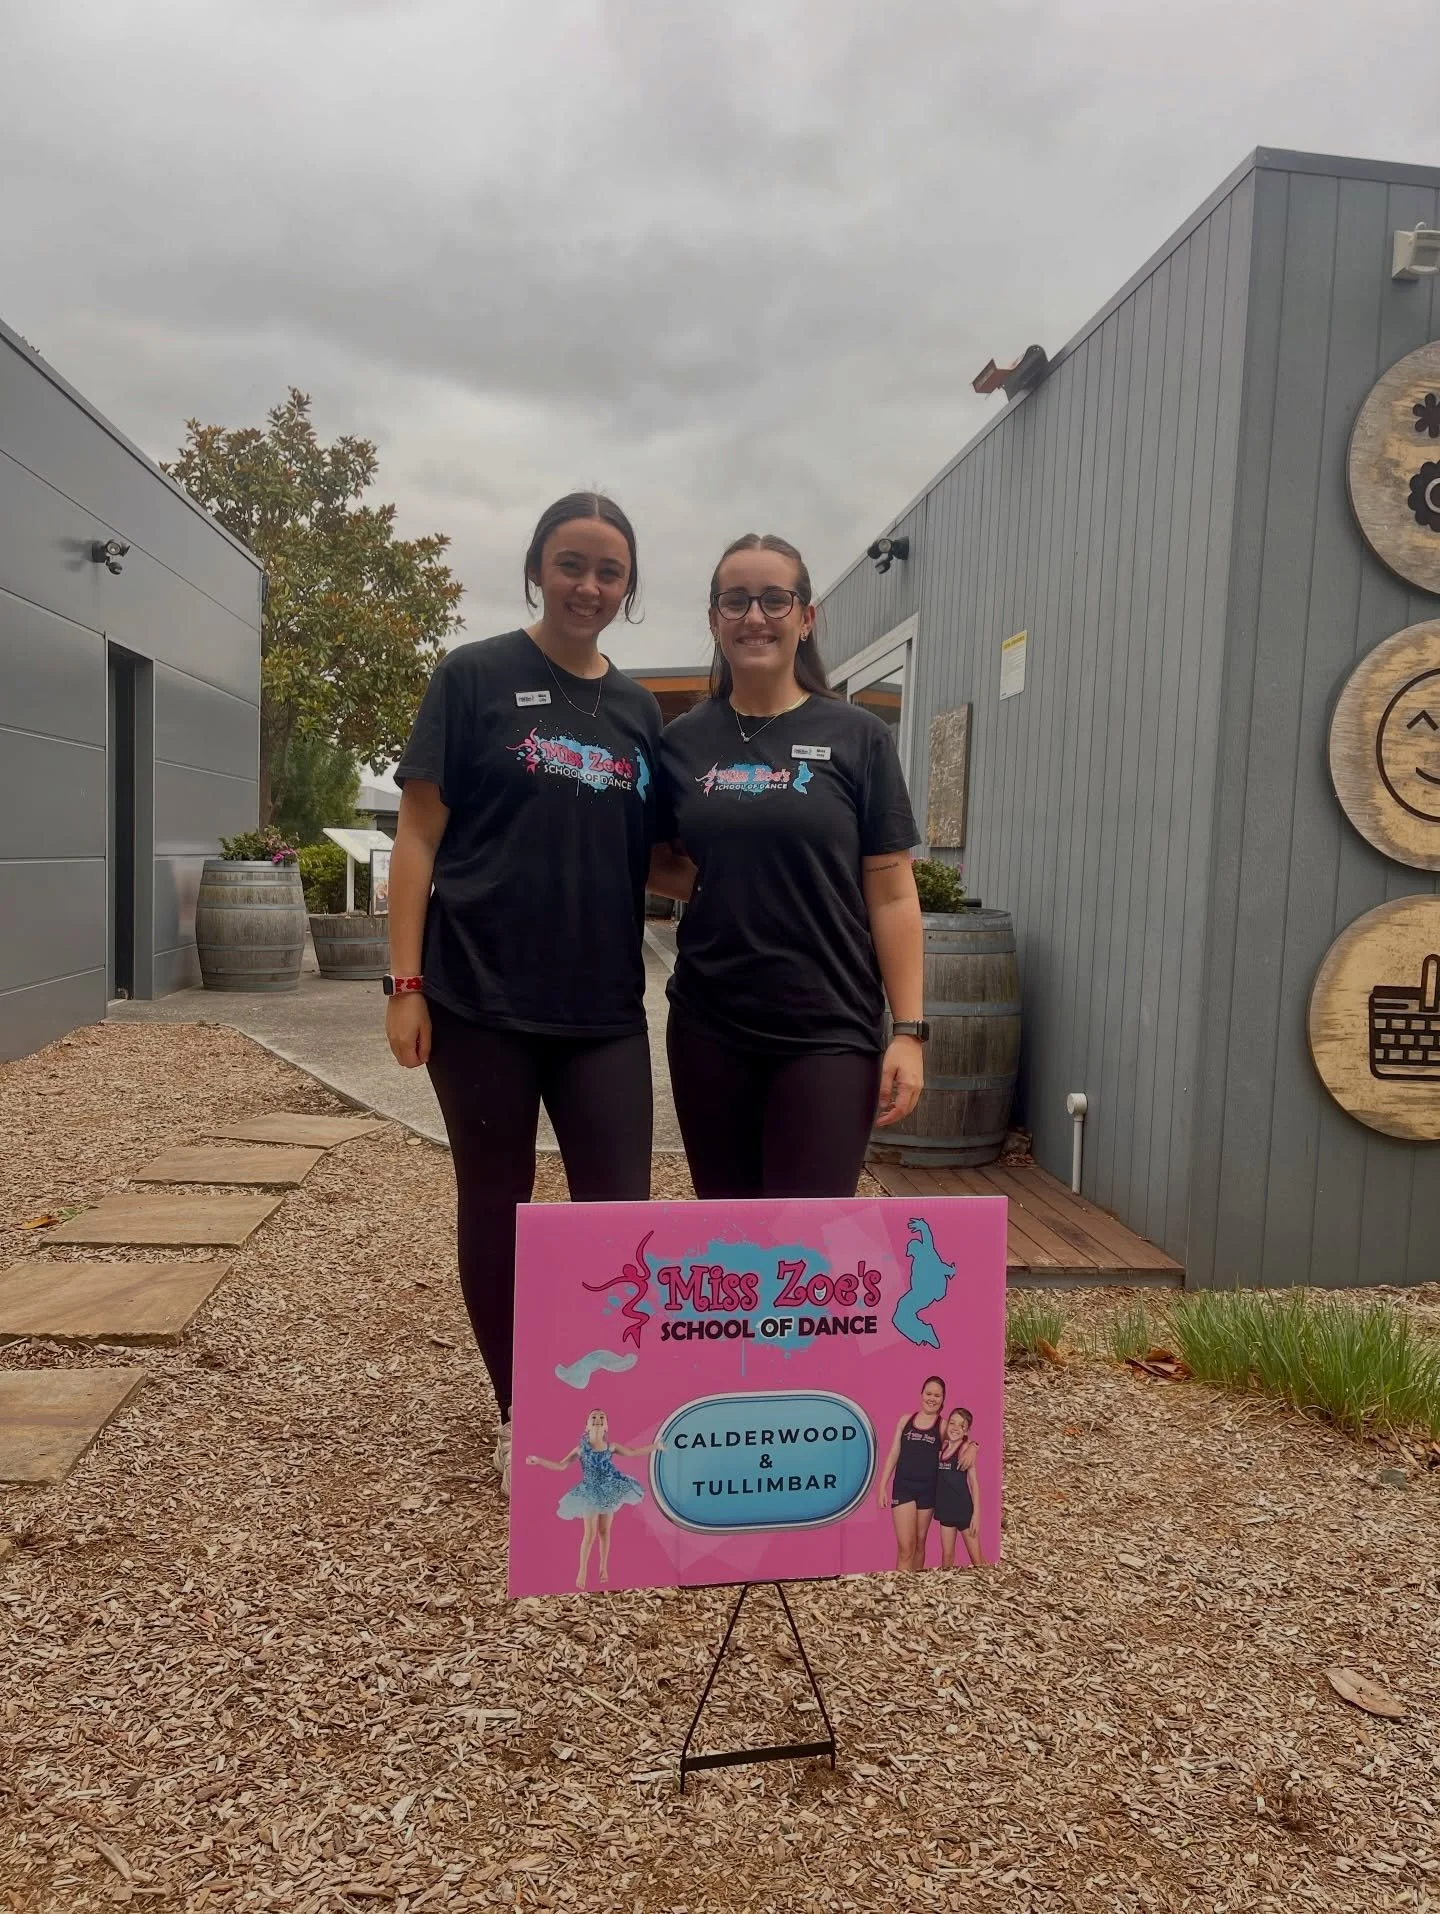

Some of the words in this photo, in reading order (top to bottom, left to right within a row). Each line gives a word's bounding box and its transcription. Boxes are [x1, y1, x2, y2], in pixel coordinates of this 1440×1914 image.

[540, 740, 584, 769] Miss
[588, 751, 633, 779] Zoe's
[544, 764, 584, 780] SCHOOL
[585, 773, 599, 782] OF
[601, 775, 632, 791] DANCE
[752, 768, 791, 783] Zoe's
[657, 1265, 759, 1312] Miss
[773, 1259, 881, 1308] Zoe's
[660, 1319, 755, 1341] SCHOOL
[760, 1317, 793, 1338] OF
[798, 1315, 878, 1337] DANCE
[674, 1425, 857, 1449] CALDERWOOD
[759, 1453, 773, 1469] &
[692, 1474, 837, 1496] TULLIMBAR
